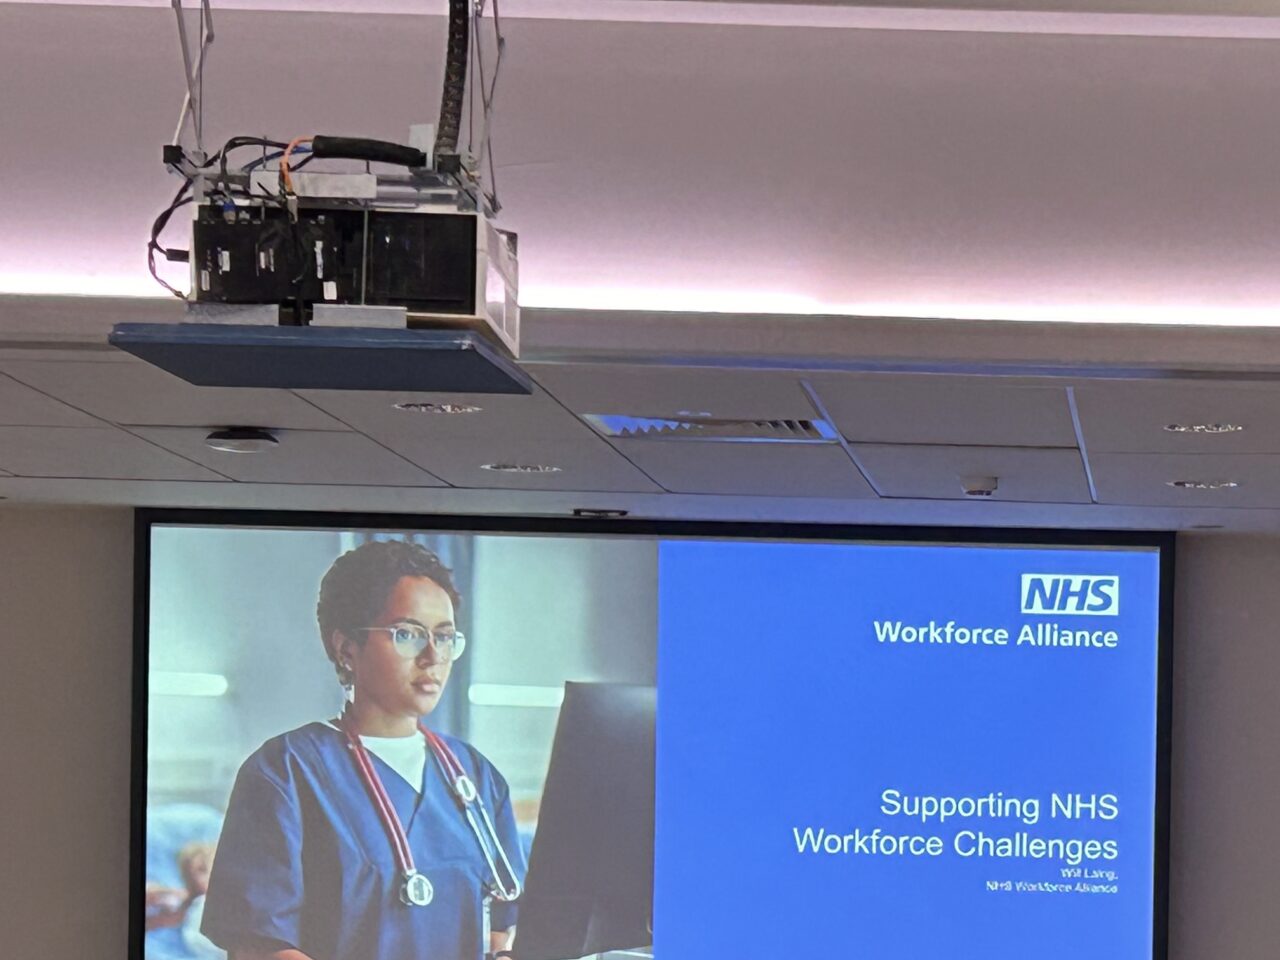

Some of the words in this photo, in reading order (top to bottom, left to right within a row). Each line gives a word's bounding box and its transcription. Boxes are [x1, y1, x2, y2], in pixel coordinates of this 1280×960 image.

[1023, 577, 1115, 612] NHS
[874, 620, 1009, 645] Workforce
[1016, 622, 1119, 648] Alliance
[880, 789, 1040, 824] Supporting
[1051, 792, 1119, 820] NHS
[793, 827, 944, 856] Workforce
[953, 830, 1119, 865] Challenges
[1015, 881, 1073, 893] Workforce
[1074, 882, 1118, 894] Alliance
